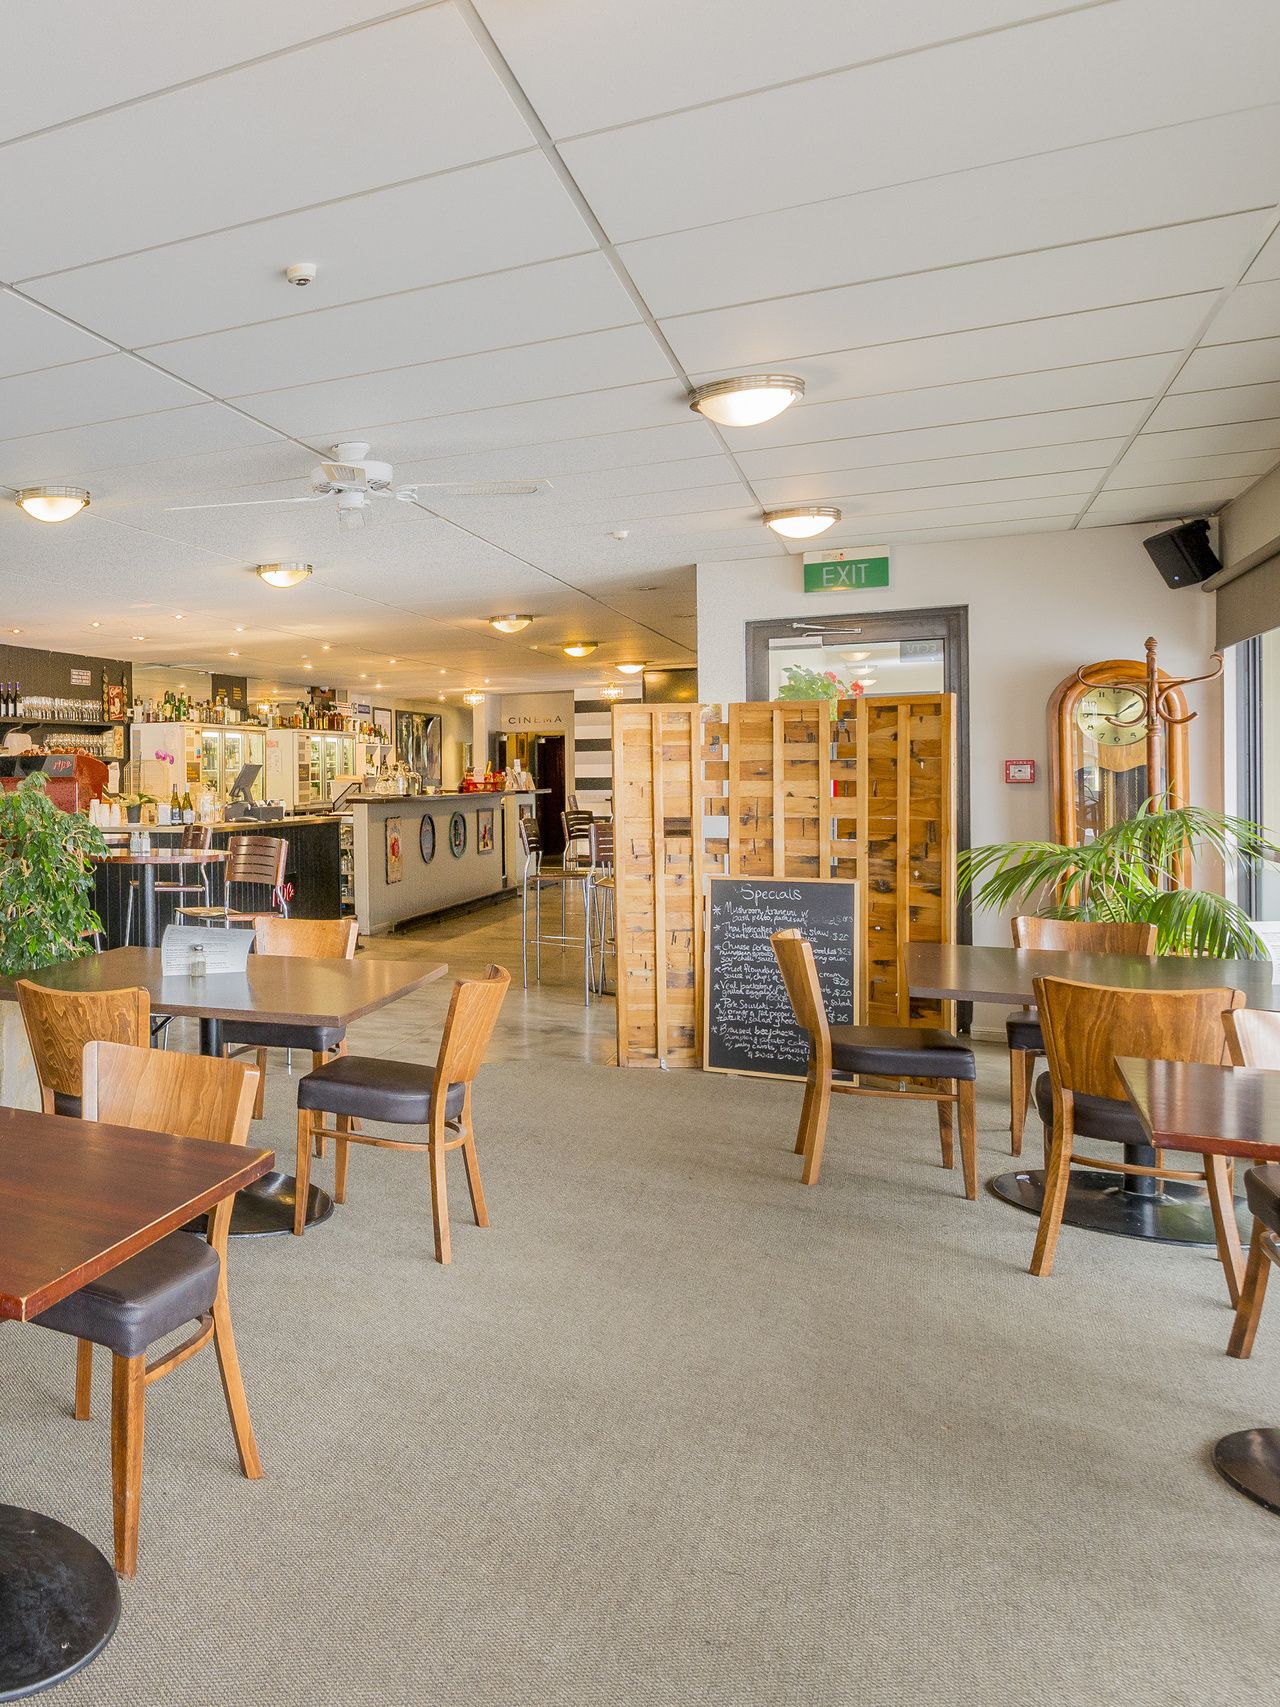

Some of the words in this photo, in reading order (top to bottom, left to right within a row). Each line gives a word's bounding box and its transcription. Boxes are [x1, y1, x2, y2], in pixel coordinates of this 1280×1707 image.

[822, 563, 869, 587] EXIT
[508, 715, 562, 725] CINEMA
[740, 883, 802, 907] Specials
